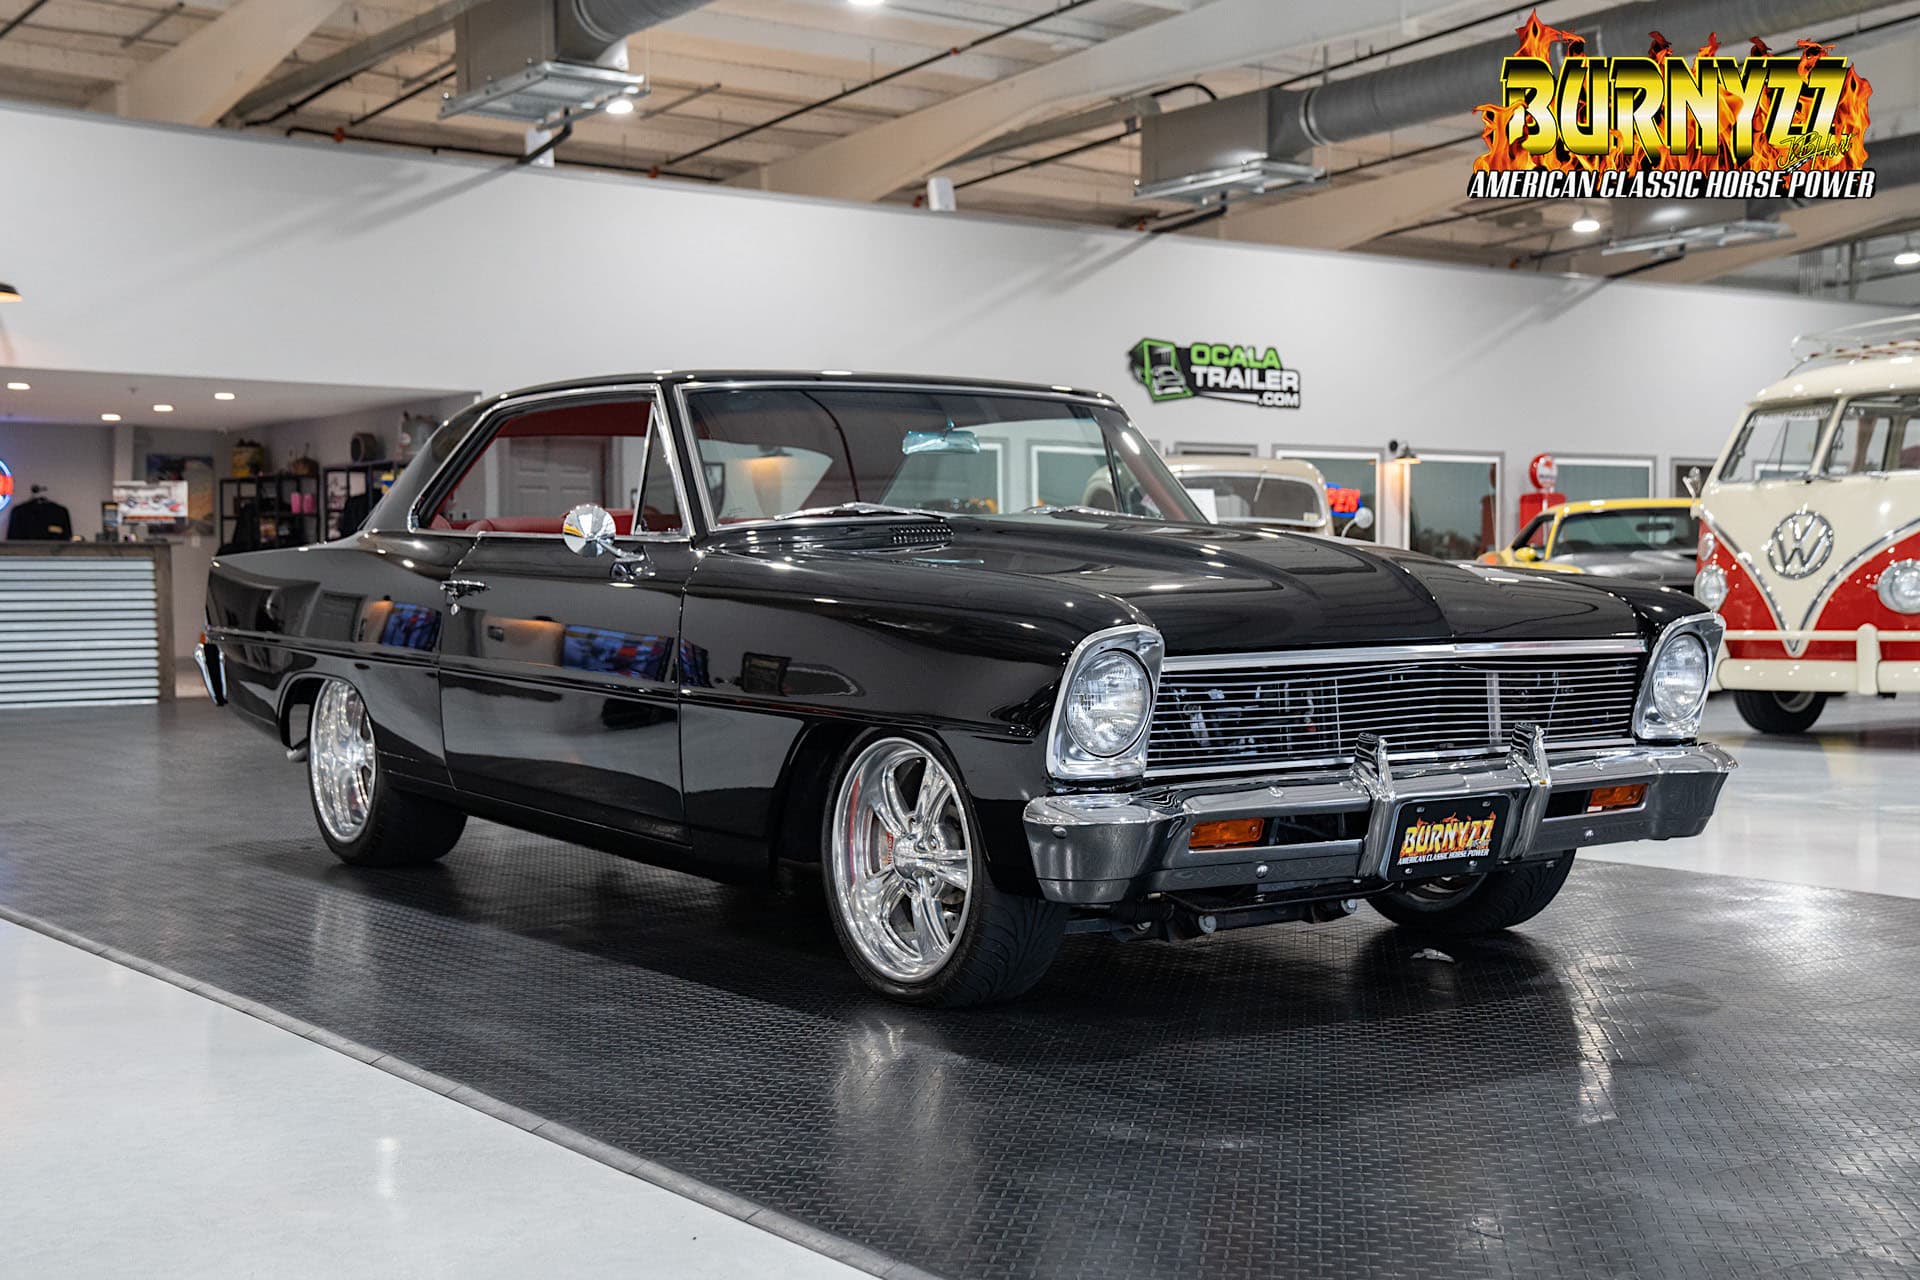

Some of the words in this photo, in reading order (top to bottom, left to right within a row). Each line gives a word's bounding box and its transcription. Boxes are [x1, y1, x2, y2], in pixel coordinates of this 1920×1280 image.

[1190, 342, 1282, 369] OCALA
[1190, 365, 1299, 391] TRAILER
[1257, 391, 1299, 407] .COM
[1326, 487, 1360, 512] PEN
[1771, 512, 1831, 577] VW
[1404, 820, 1494, 853] BURNYZZ
[1397, 855, 1426, 865] AMERICAN
[1467, 849, 1490, 857] POWER
